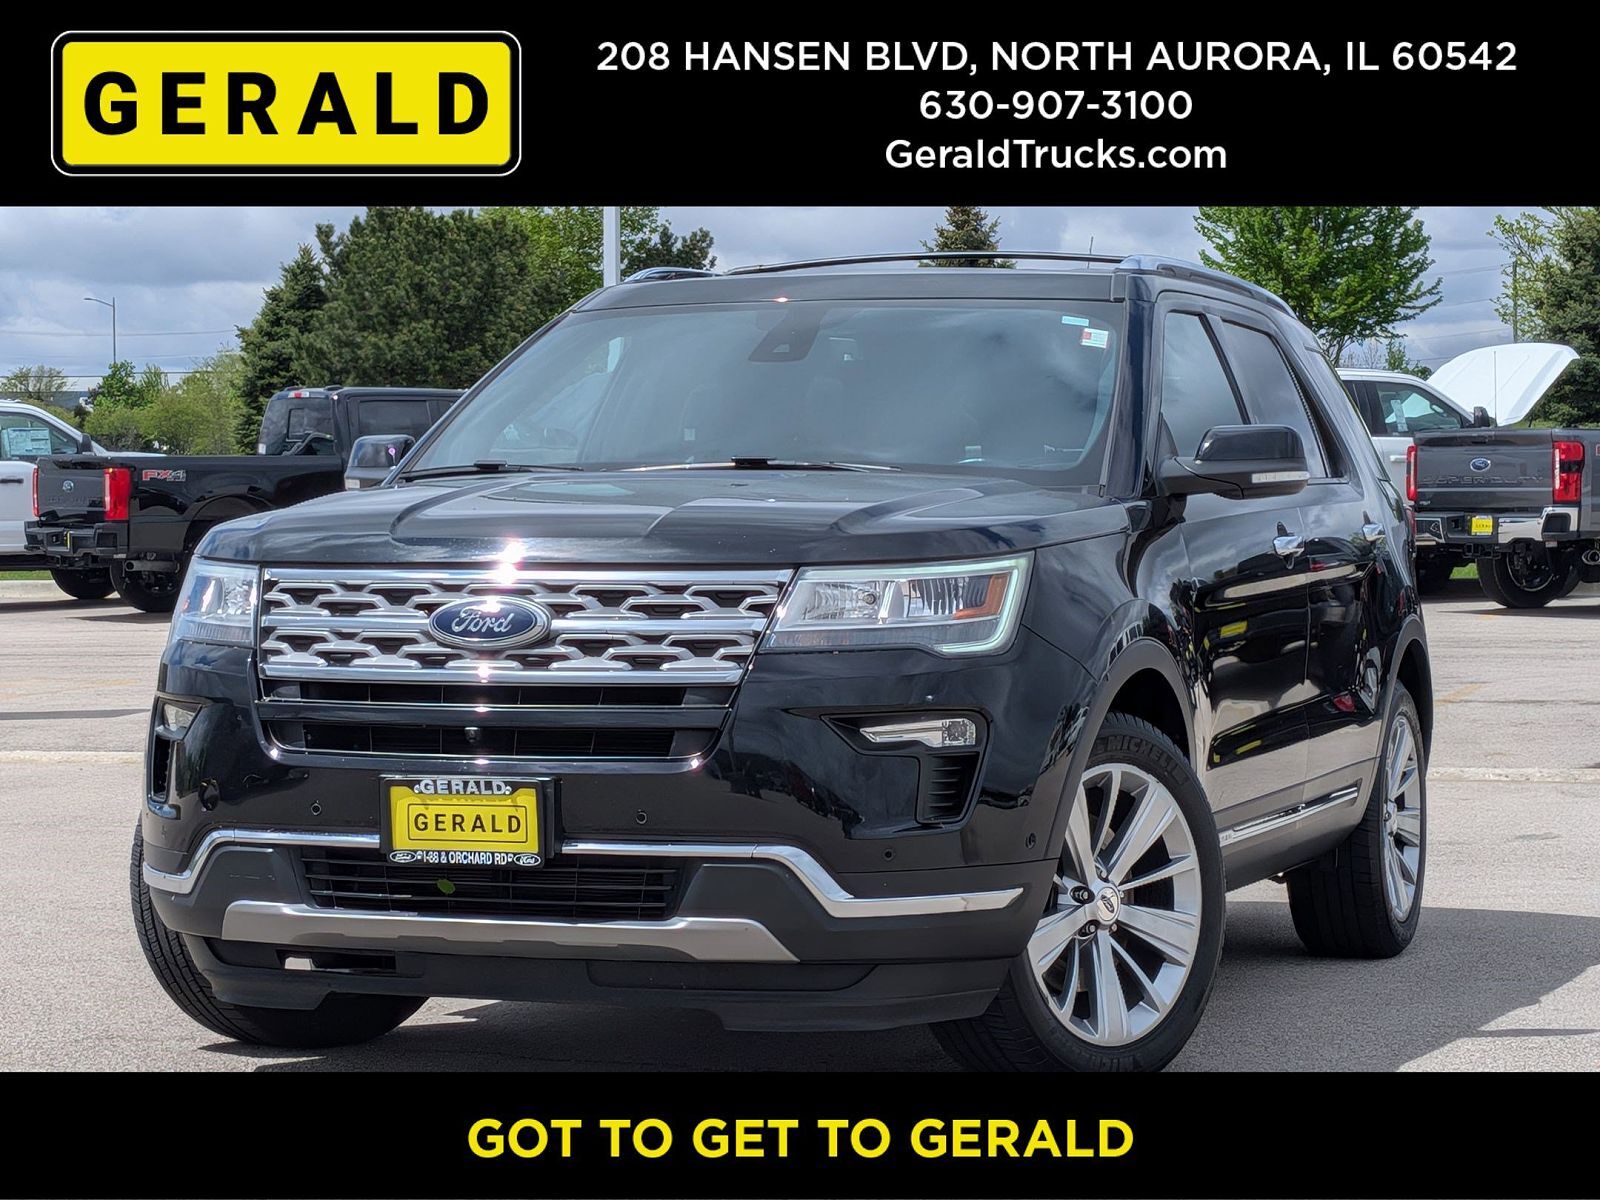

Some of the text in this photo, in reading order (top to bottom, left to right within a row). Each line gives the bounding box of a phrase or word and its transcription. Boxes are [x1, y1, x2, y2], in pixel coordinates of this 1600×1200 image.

[142, 469, 186, 481] FX4
[451, 604, 514, 633] Ford
[419, 779, 507, 795] GERALD
[414, 813, 522, 833] GERALD
[448, 851, 493, 865] ORCHARD
[494, 853, 507, 865] RD
